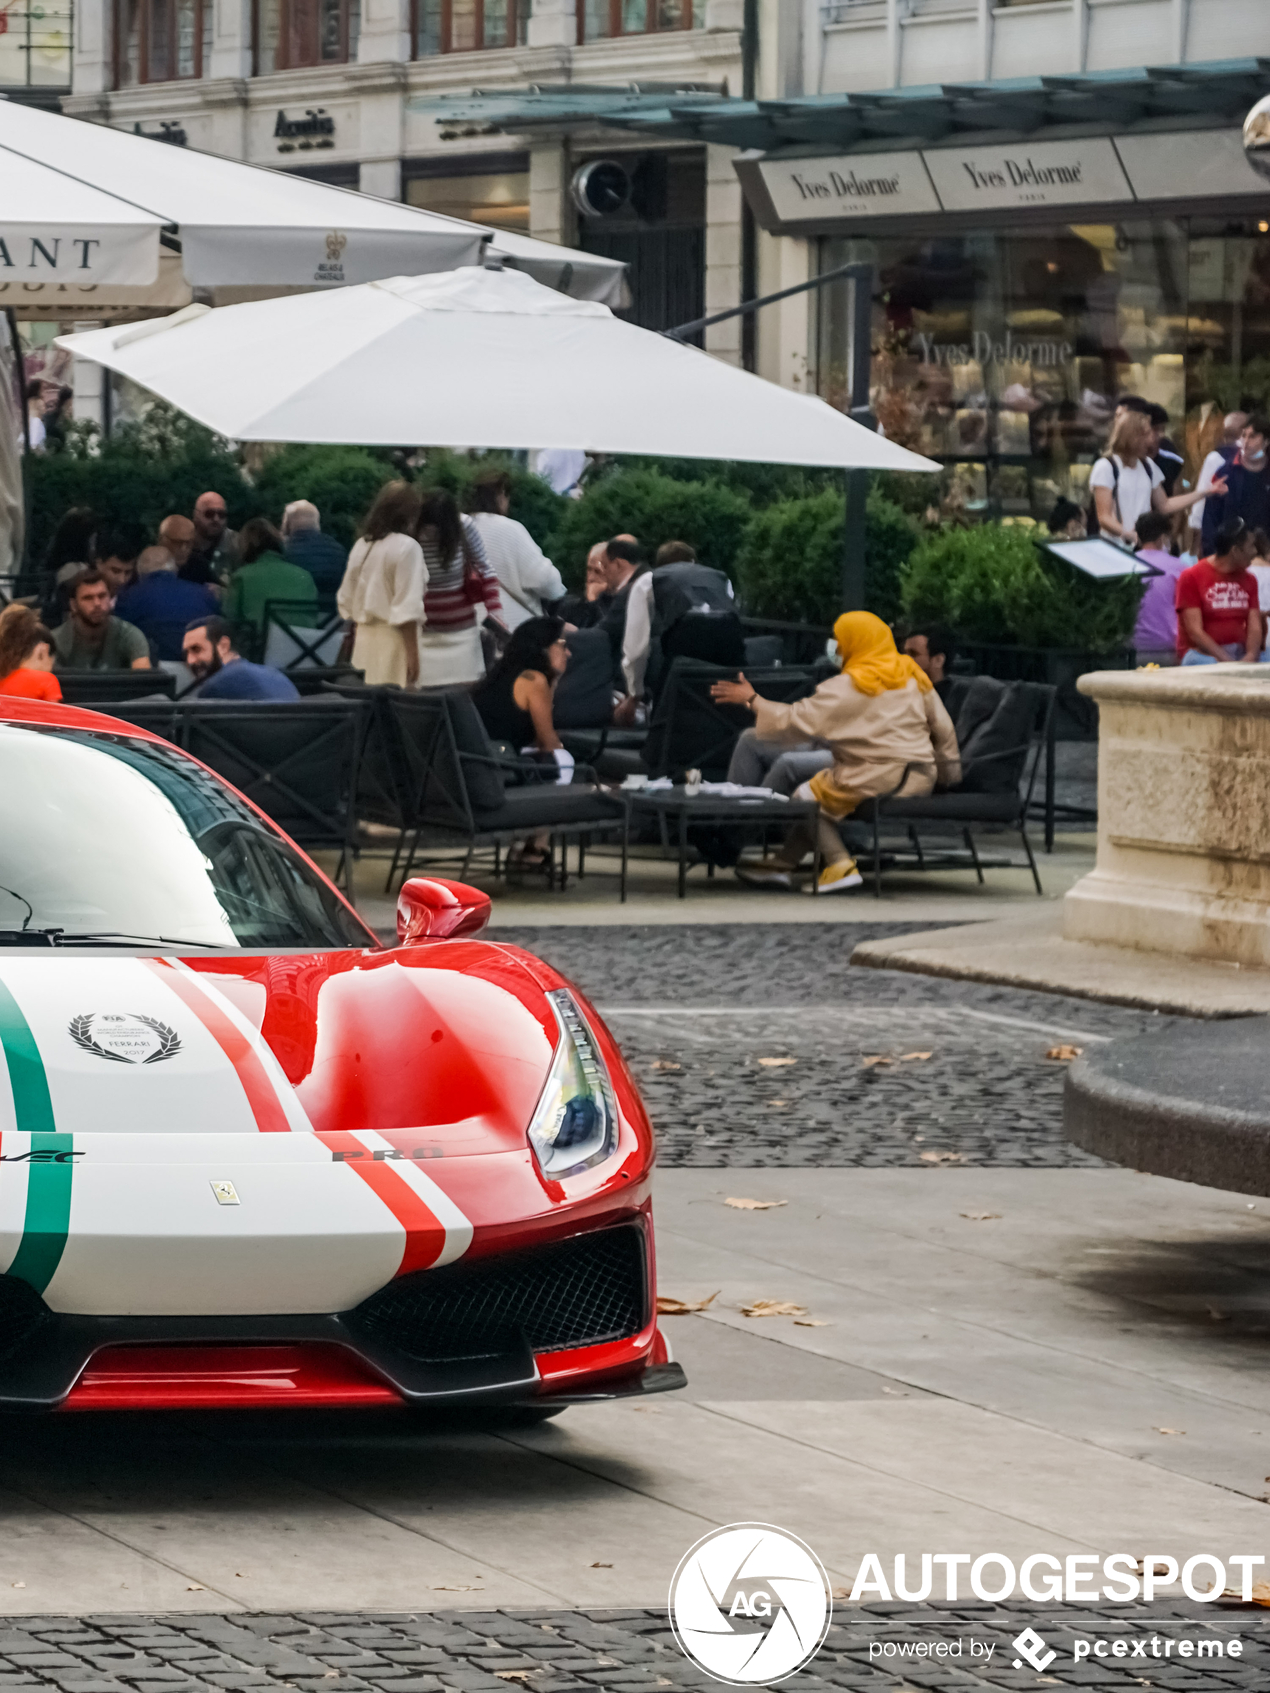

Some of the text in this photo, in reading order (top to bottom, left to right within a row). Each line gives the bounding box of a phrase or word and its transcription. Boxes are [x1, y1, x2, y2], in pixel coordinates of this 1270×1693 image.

[791, 170, 900, 200] Yves Delorme
[963, 159, 1081, 189] Yves Delorme
[919, 330, 1072, 366] Yves Delorme
[332, 1147, 444, 1162] PRO
